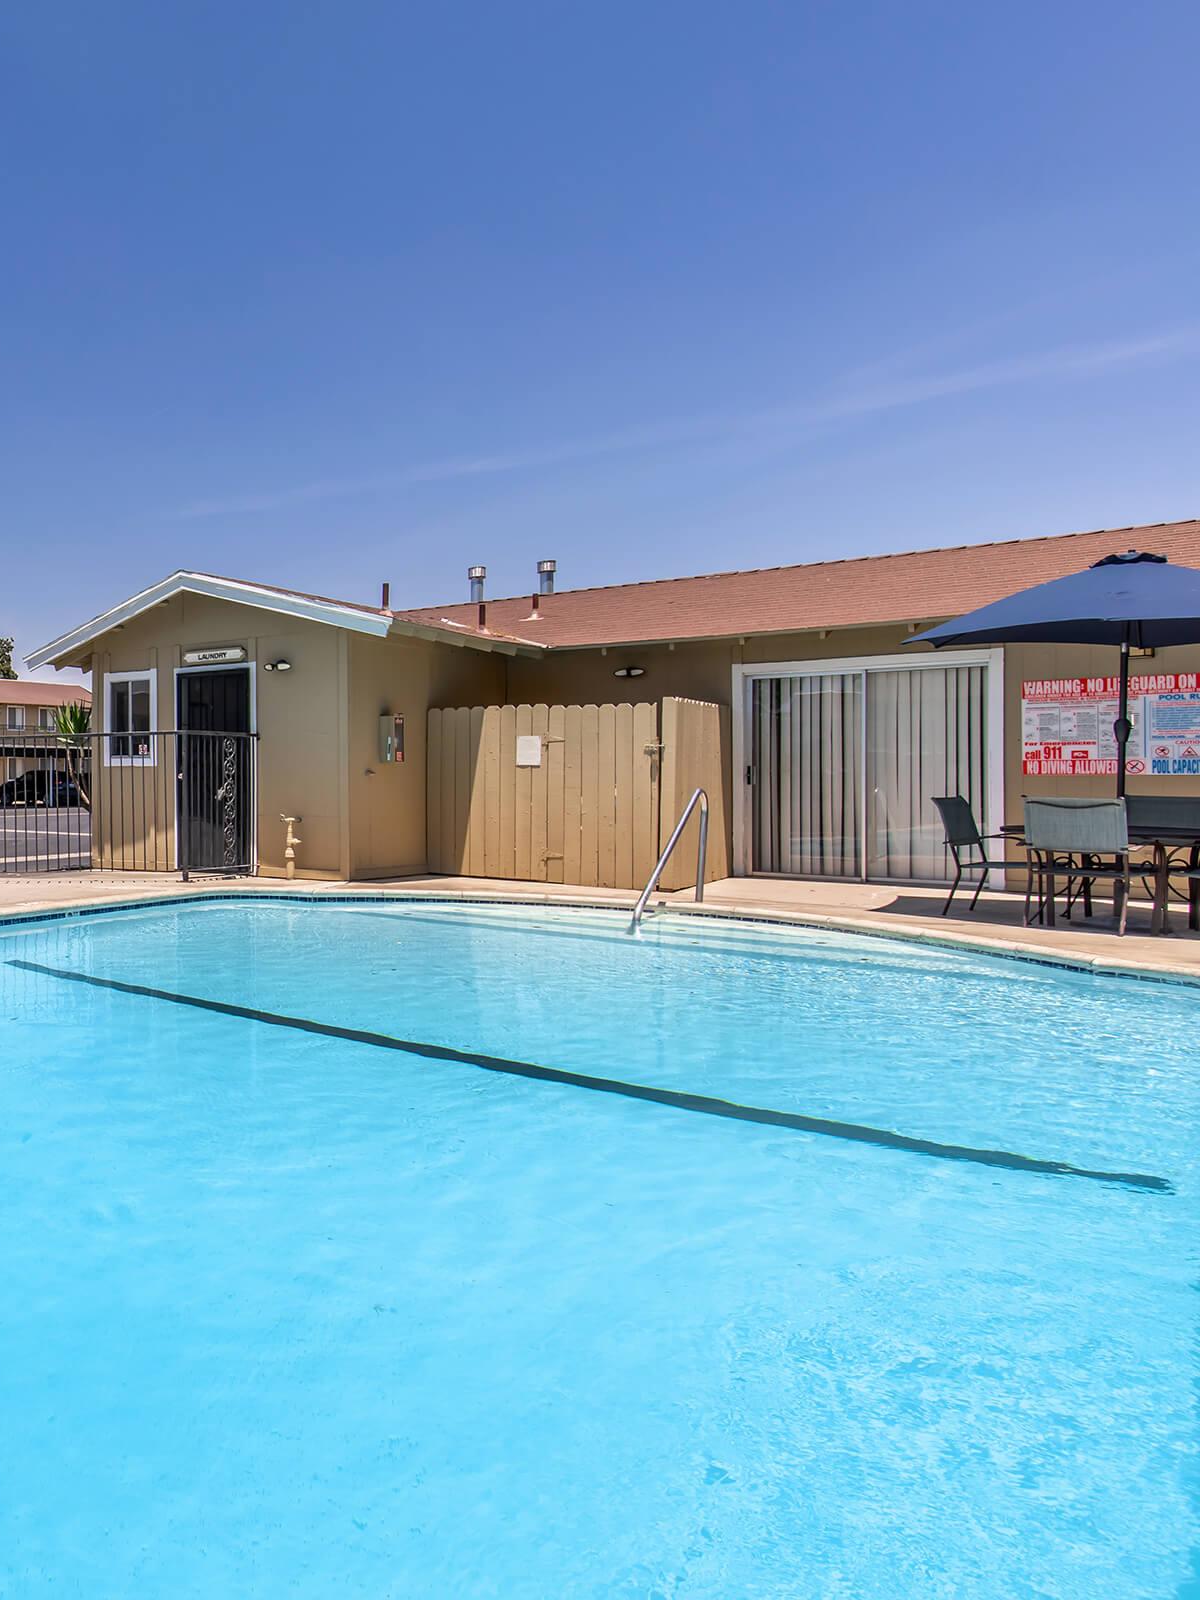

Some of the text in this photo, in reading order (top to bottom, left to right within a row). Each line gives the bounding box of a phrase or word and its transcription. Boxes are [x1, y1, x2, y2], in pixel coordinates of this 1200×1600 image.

[198, 652, 226, 661] LAUNDRY
[1023, 679, 1085, 695] WARNING:
[1087, 677, 1104, 692] NO
[1178, 673, 1197, 688] ON
[1025, 745, 1062, 760] call 911
[1027, 760, 1118, 774] NO DIVING ALLOWED
[1152, 760, 1171, 773] POOL
